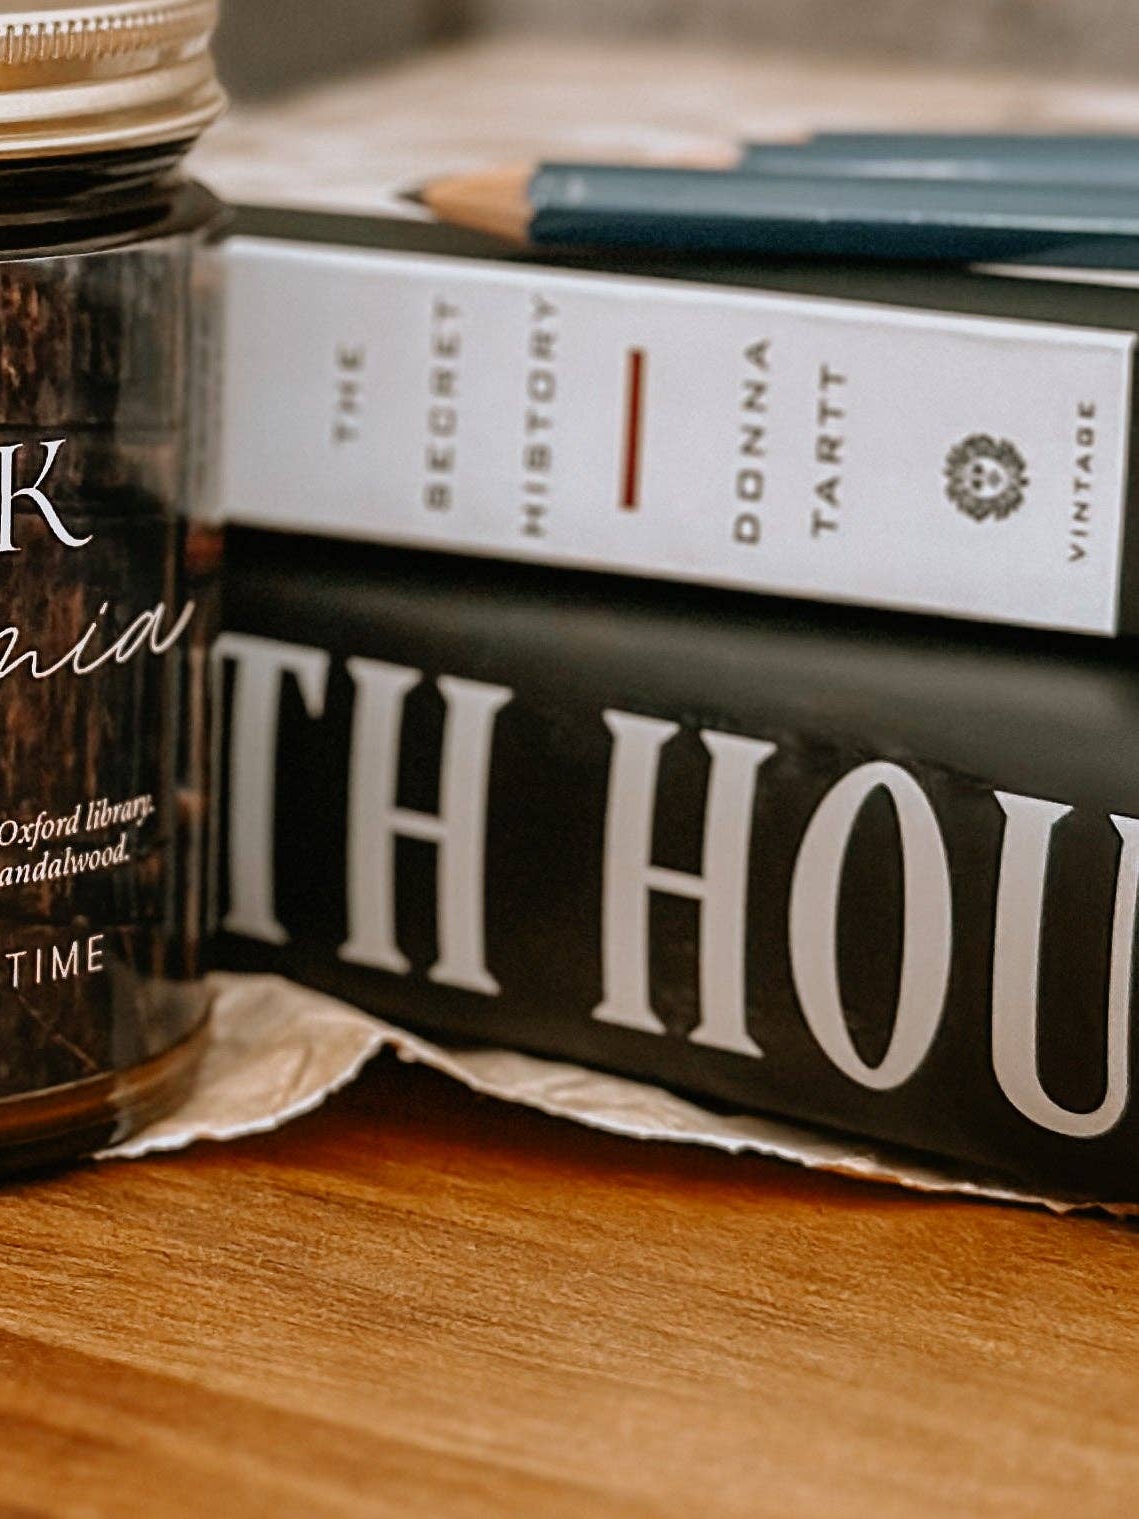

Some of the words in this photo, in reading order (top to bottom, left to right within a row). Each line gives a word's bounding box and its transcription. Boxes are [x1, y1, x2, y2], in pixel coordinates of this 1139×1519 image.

[331, 343, 366, 447] THE
[424, 299, 464, 512] SECRET
[522, 292, 562, 538] HISTORY
[733, 337, 772, 546] DONNA
[810, 363, 849, 540] TARTT
[1068, 399, 1097, 562] VINTAGE
[86, 793, 157, 832] library.
[5, 934, 105, 989] TIME
[591, 709, 1139, 1139] HOU
